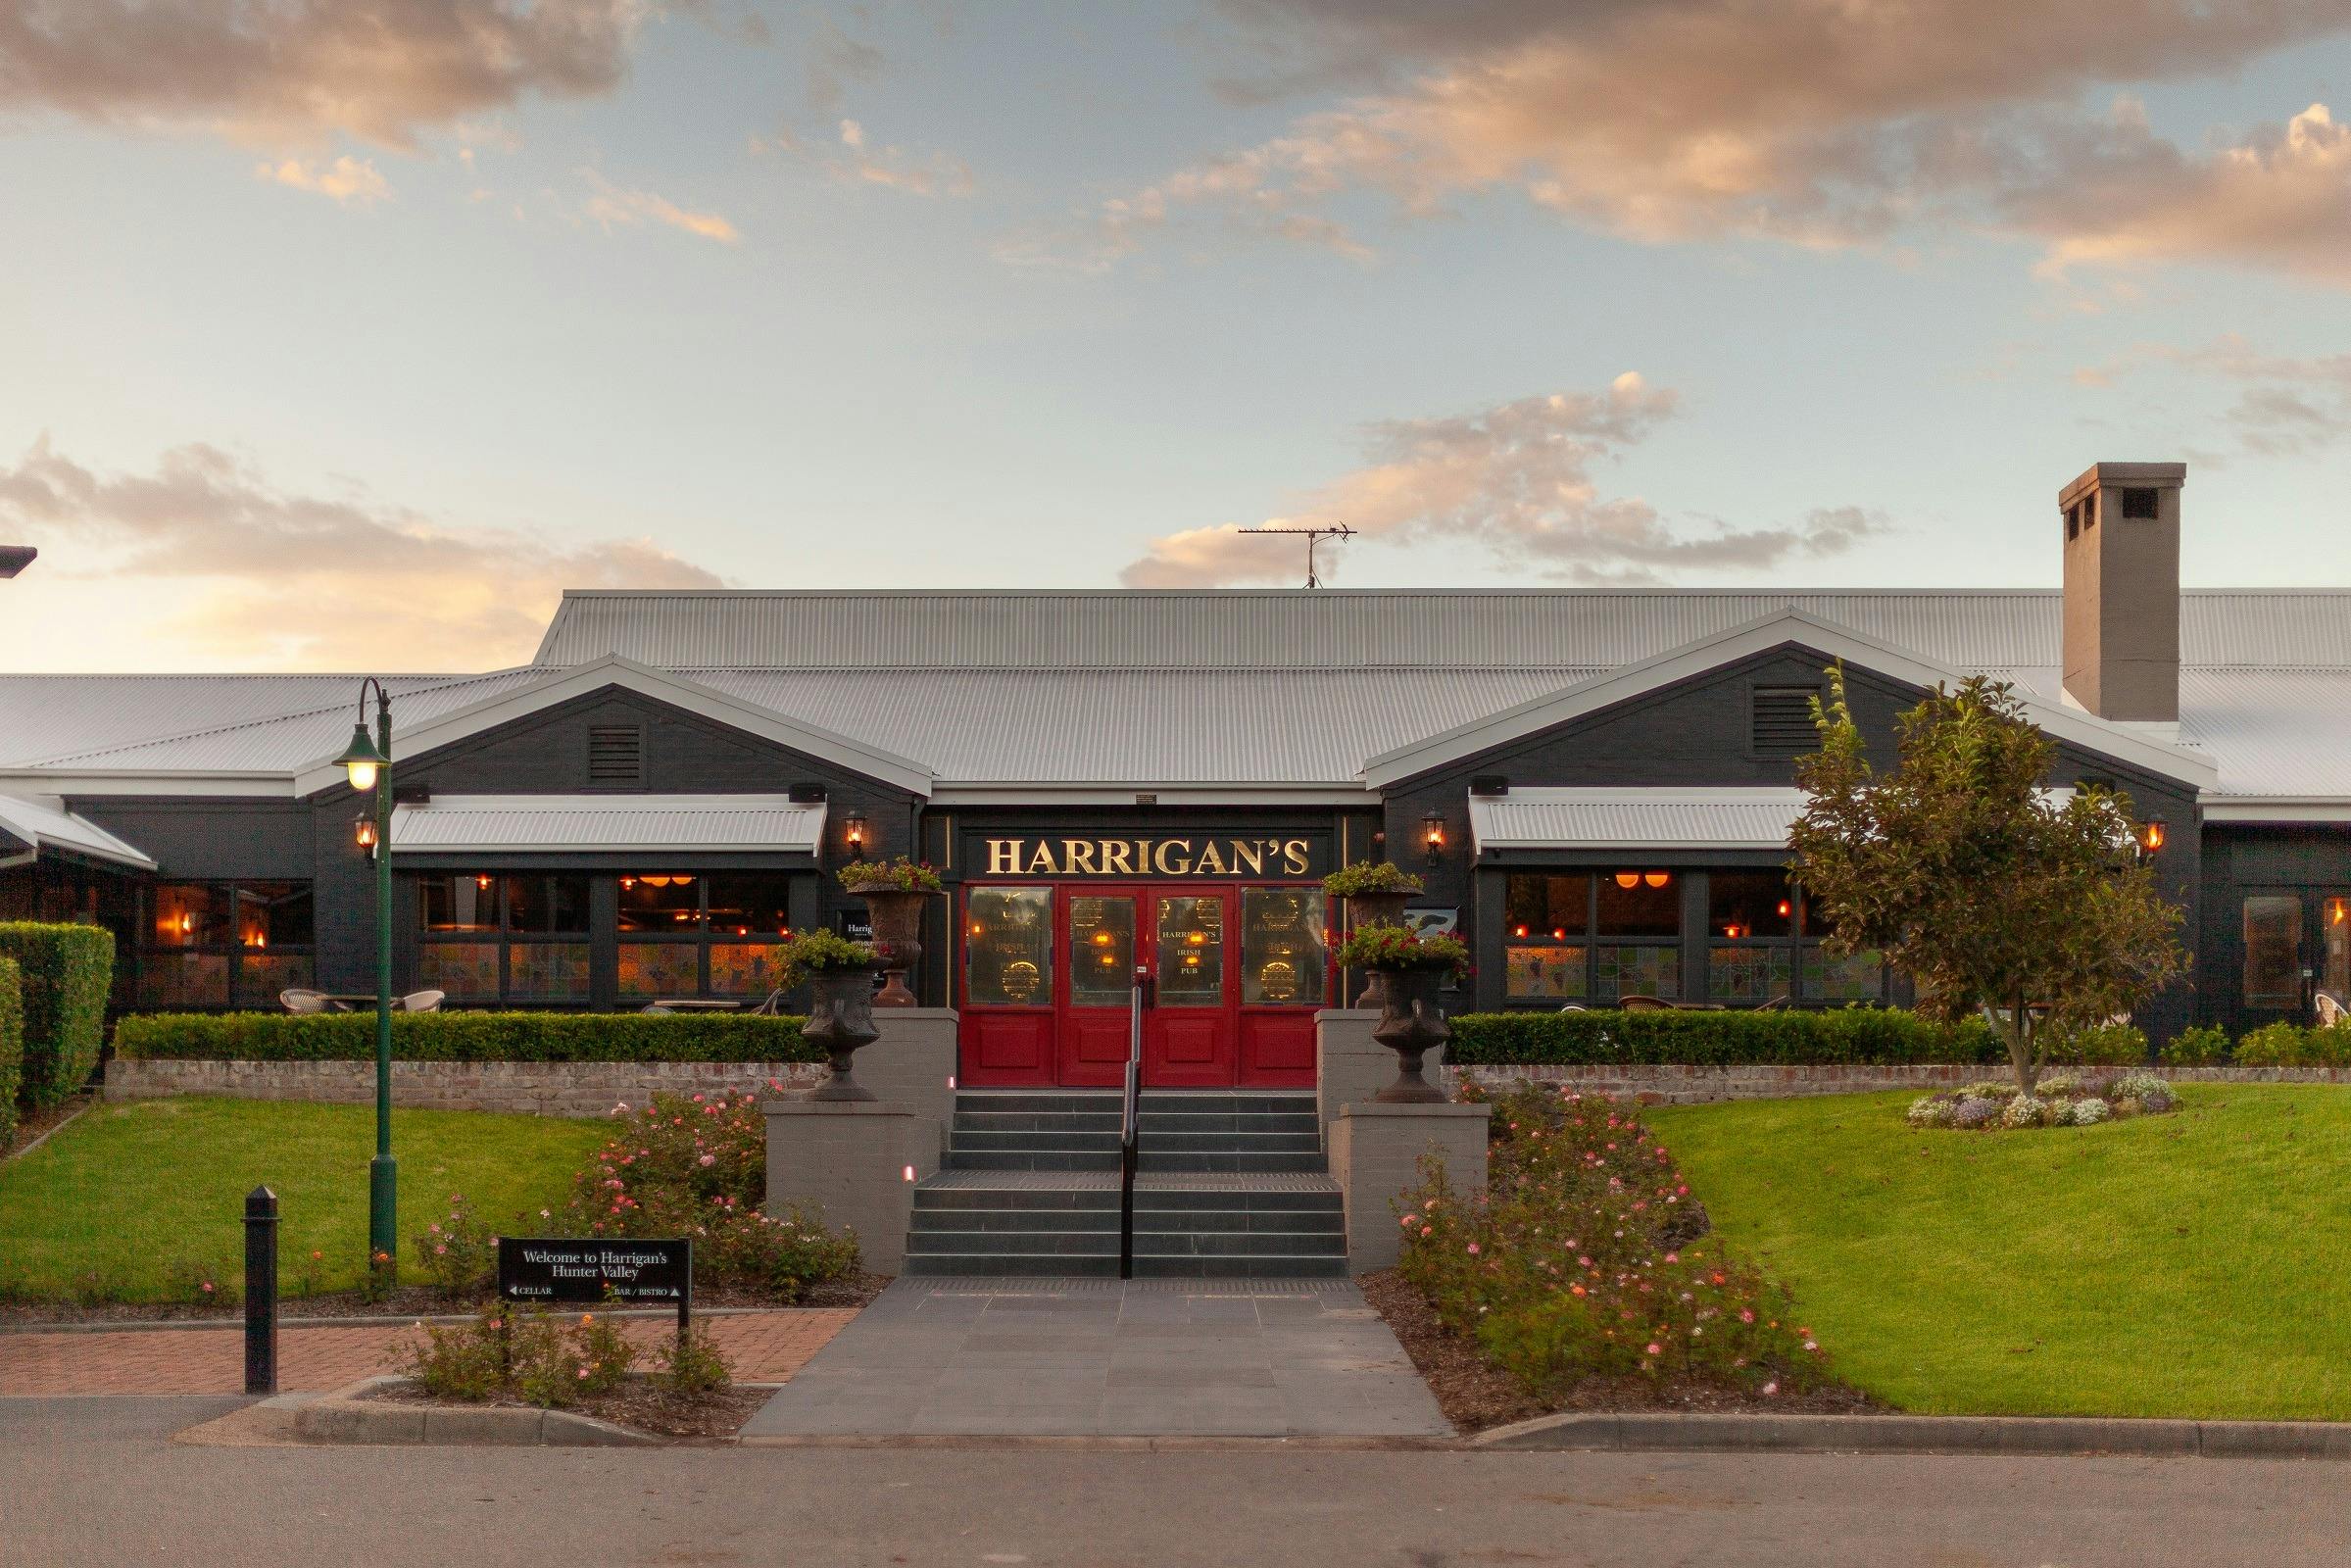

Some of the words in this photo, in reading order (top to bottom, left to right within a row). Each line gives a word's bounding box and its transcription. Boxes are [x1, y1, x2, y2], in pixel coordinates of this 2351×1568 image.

[986, 840, 1309, 875] HARRIGAN'S
[848, 924, 873, 934] Harrig
[523, 1250, 580, 1263] Welcome
[584, 1252, 597, 1263] to
[600, 1251, 667, 1268] Harrigan's
[552, 1265, 598, 1278] Hunter
[601, 1265, 639, 1281] Valley
